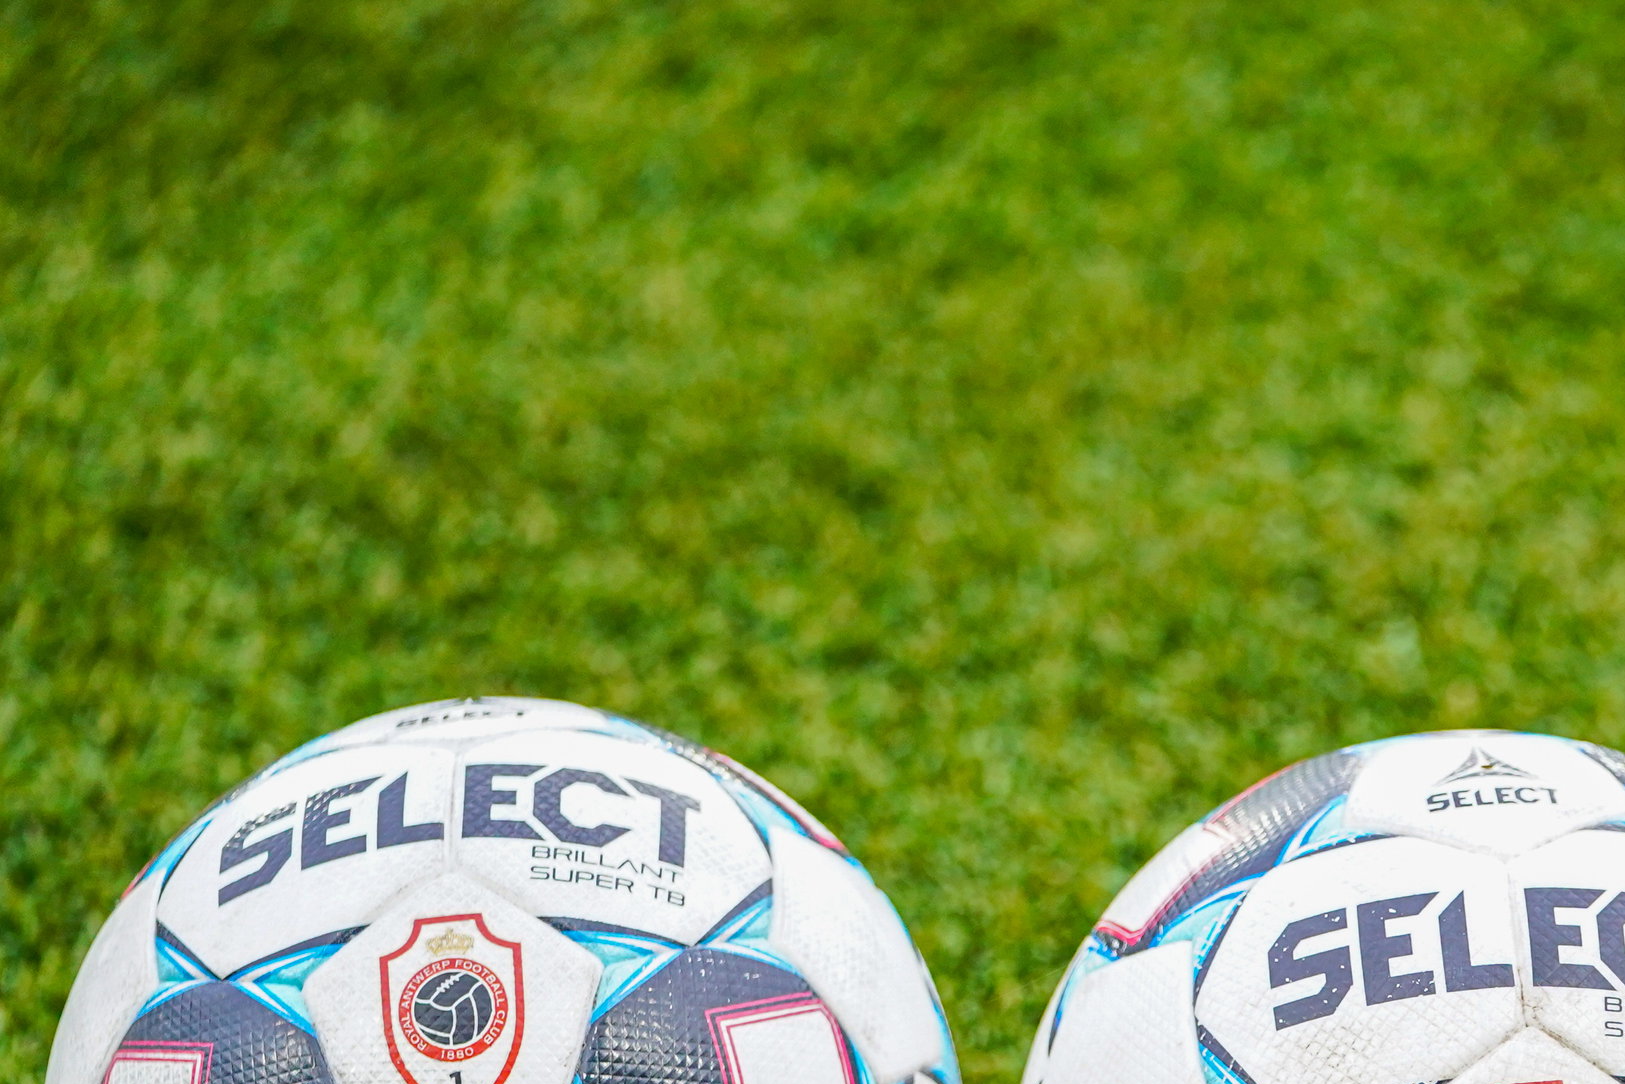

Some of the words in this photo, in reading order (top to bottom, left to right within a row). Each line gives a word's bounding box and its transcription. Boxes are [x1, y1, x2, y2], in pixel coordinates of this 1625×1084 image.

[1426, 787, 1558, 813] SELECT
[217, 762, 701, 906] SELECT
[531, 845, 684, 884] BRILLANT
[530, 865, 635, 894] SUPER
[646, 882, 685, 907] TB
[400, 959, 451, 1010] ANTWERP
[454, 959, 506, 1007] FOOTBALL
[400, 1011, 428, 1051] ROYAL
[483, 1009, 506, 1046] CLUB
[440, 1045, 475, 1060] 1880
